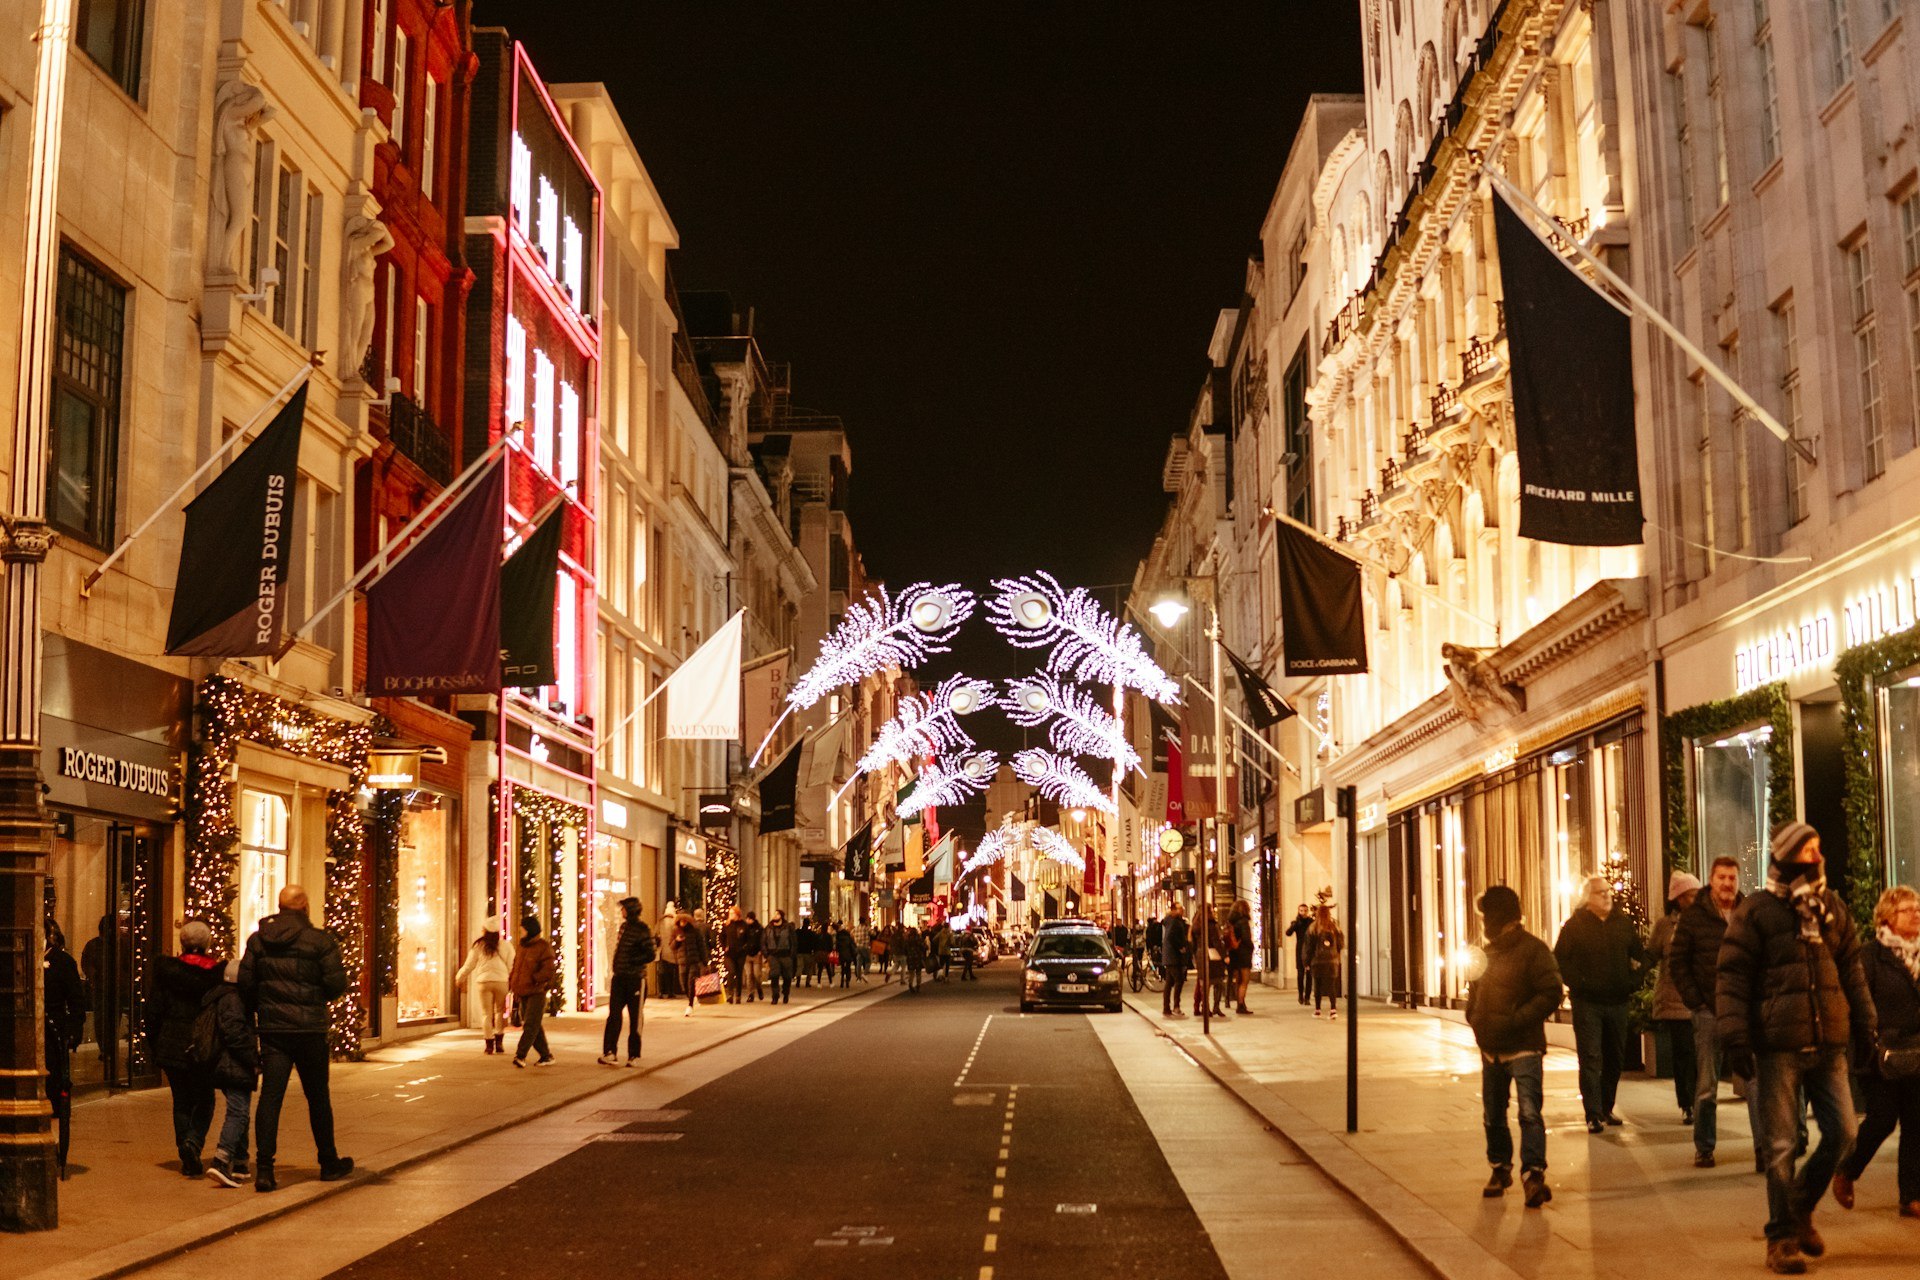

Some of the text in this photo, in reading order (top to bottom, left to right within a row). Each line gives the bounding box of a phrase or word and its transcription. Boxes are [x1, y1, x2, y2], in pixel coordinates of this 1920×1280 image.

[1525, 484, 1635, 503] RICHARD MILLE
[257, 474, 285, 645] ROGER DUBUIS
[1734, 617, 1830, 691] RICHARD
[384, 674, 486, 691] BOGHOSSIAN
[669, 724, 737, 737] VALENTINO
[64, 746, 169, 798] ROGER DUBUIS
[1124, 817, 1132, 853] PRADA
